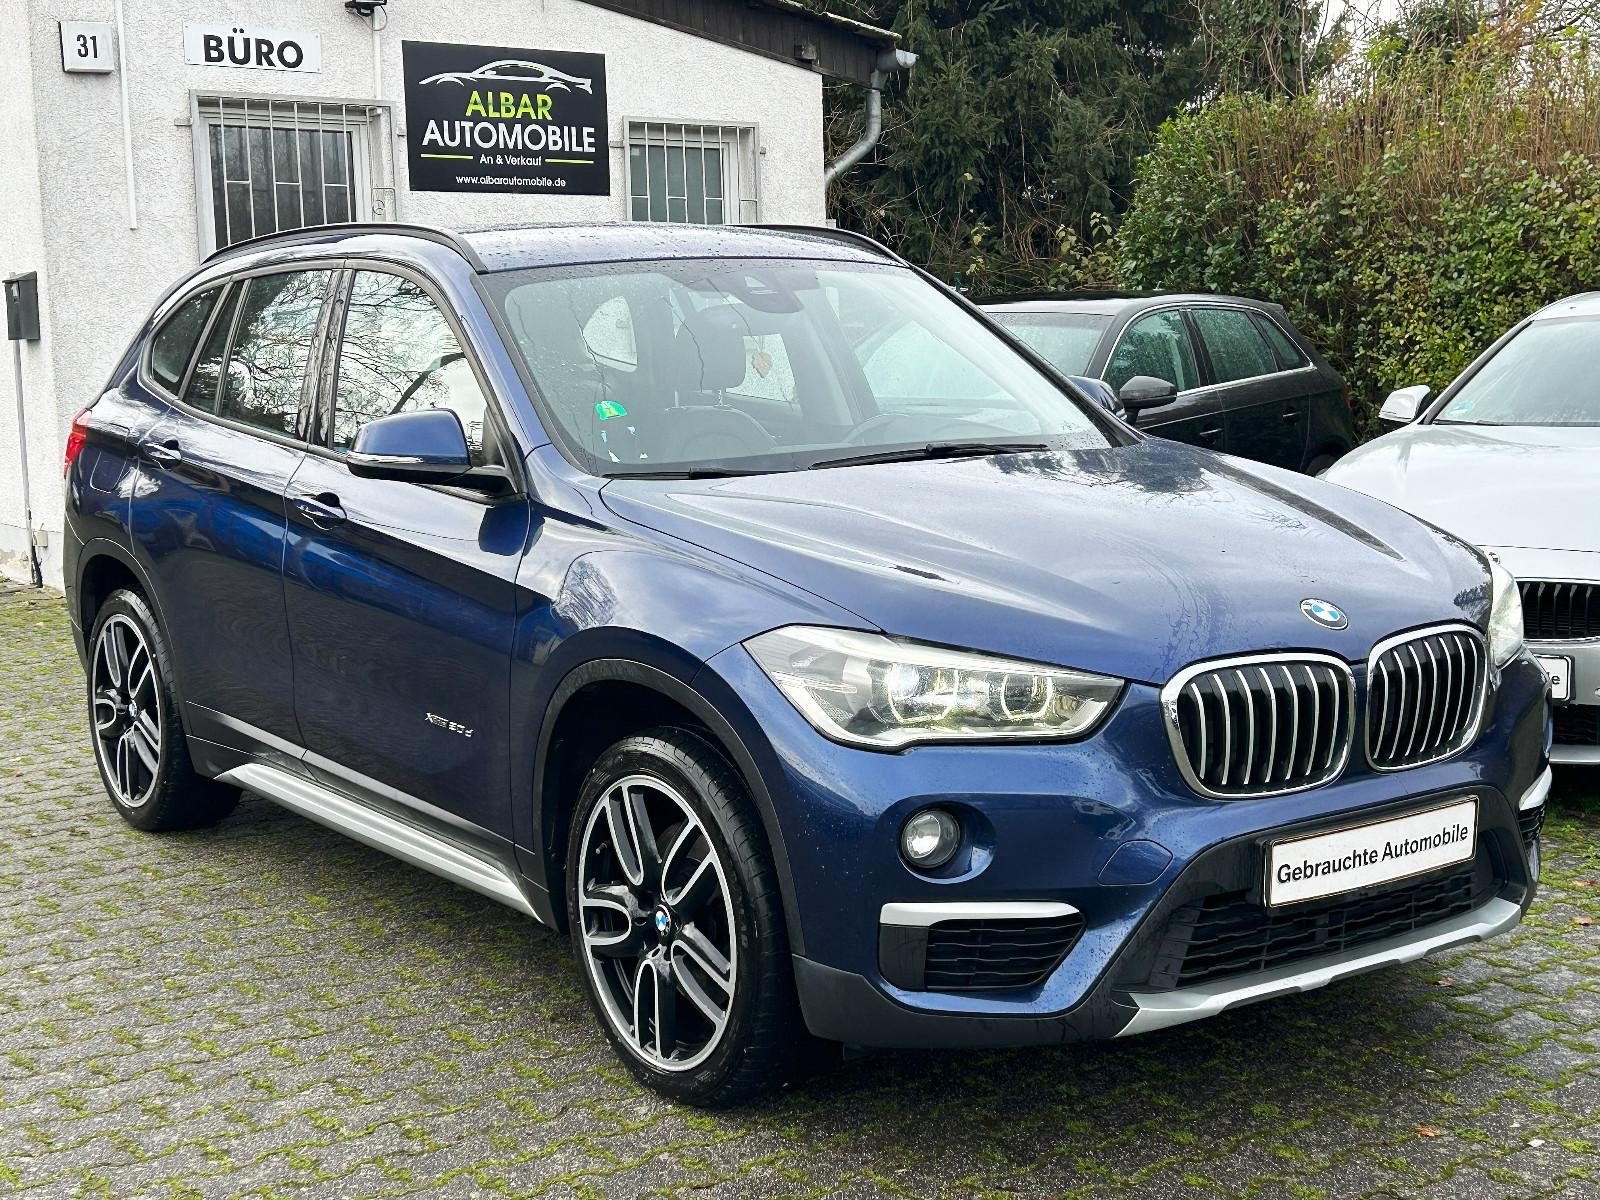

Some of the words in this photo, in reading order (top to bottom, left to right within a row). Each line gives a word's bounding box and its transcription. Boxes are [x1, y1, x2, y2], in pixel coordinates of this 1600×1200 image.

[76, 34, 98, 58] 31
[203, 27, 304, 69] BÜRO
[465, 90, 552, 120] ALBAR
[421, 119, 596, 153] AUTOMOBILE
[479, 154, 494, 165] An
[496, 155, 503, 165] &
[504, 155, 542, 166] Verkauf
[455, 175, 566, 187] www.albarautomobile.de
[1277, 848, 1379, 884] Gebrauchte
[1381, 823, 1469, 862] Automobile
